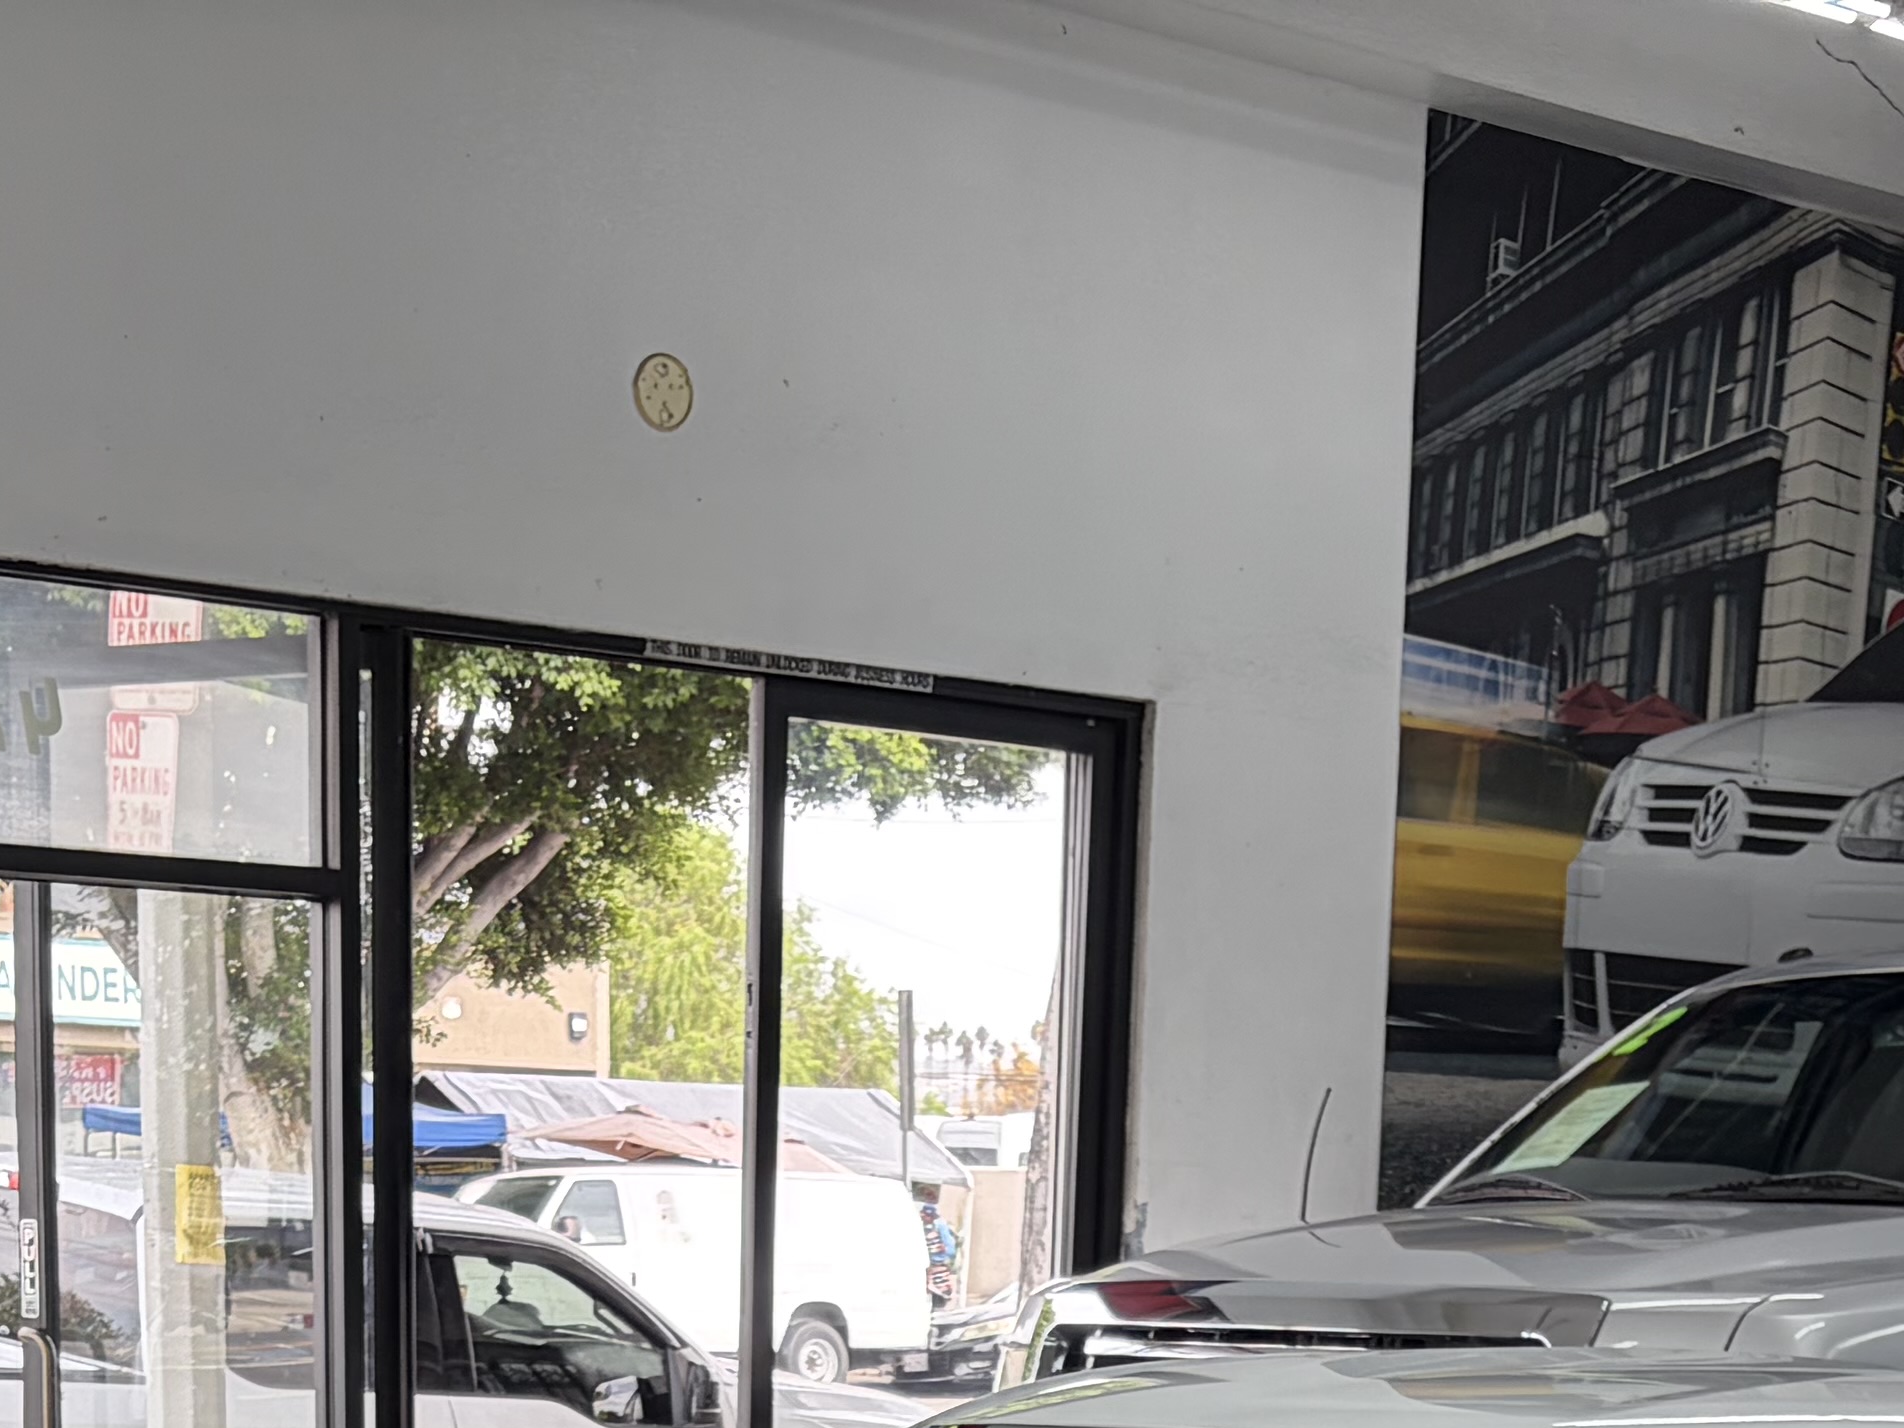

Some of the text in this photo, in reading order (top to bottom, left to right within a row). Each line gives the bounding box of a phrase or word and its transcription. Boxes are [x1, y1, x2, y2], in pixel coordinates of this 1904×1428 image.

[114, 590, 145, 617] NO
[116, 621, 192, 642] PARKING
[111, 720, 138, 756] NO
[113, 766, 170, 796] PARKING
[23, 1228, 36, 1295] PULL
